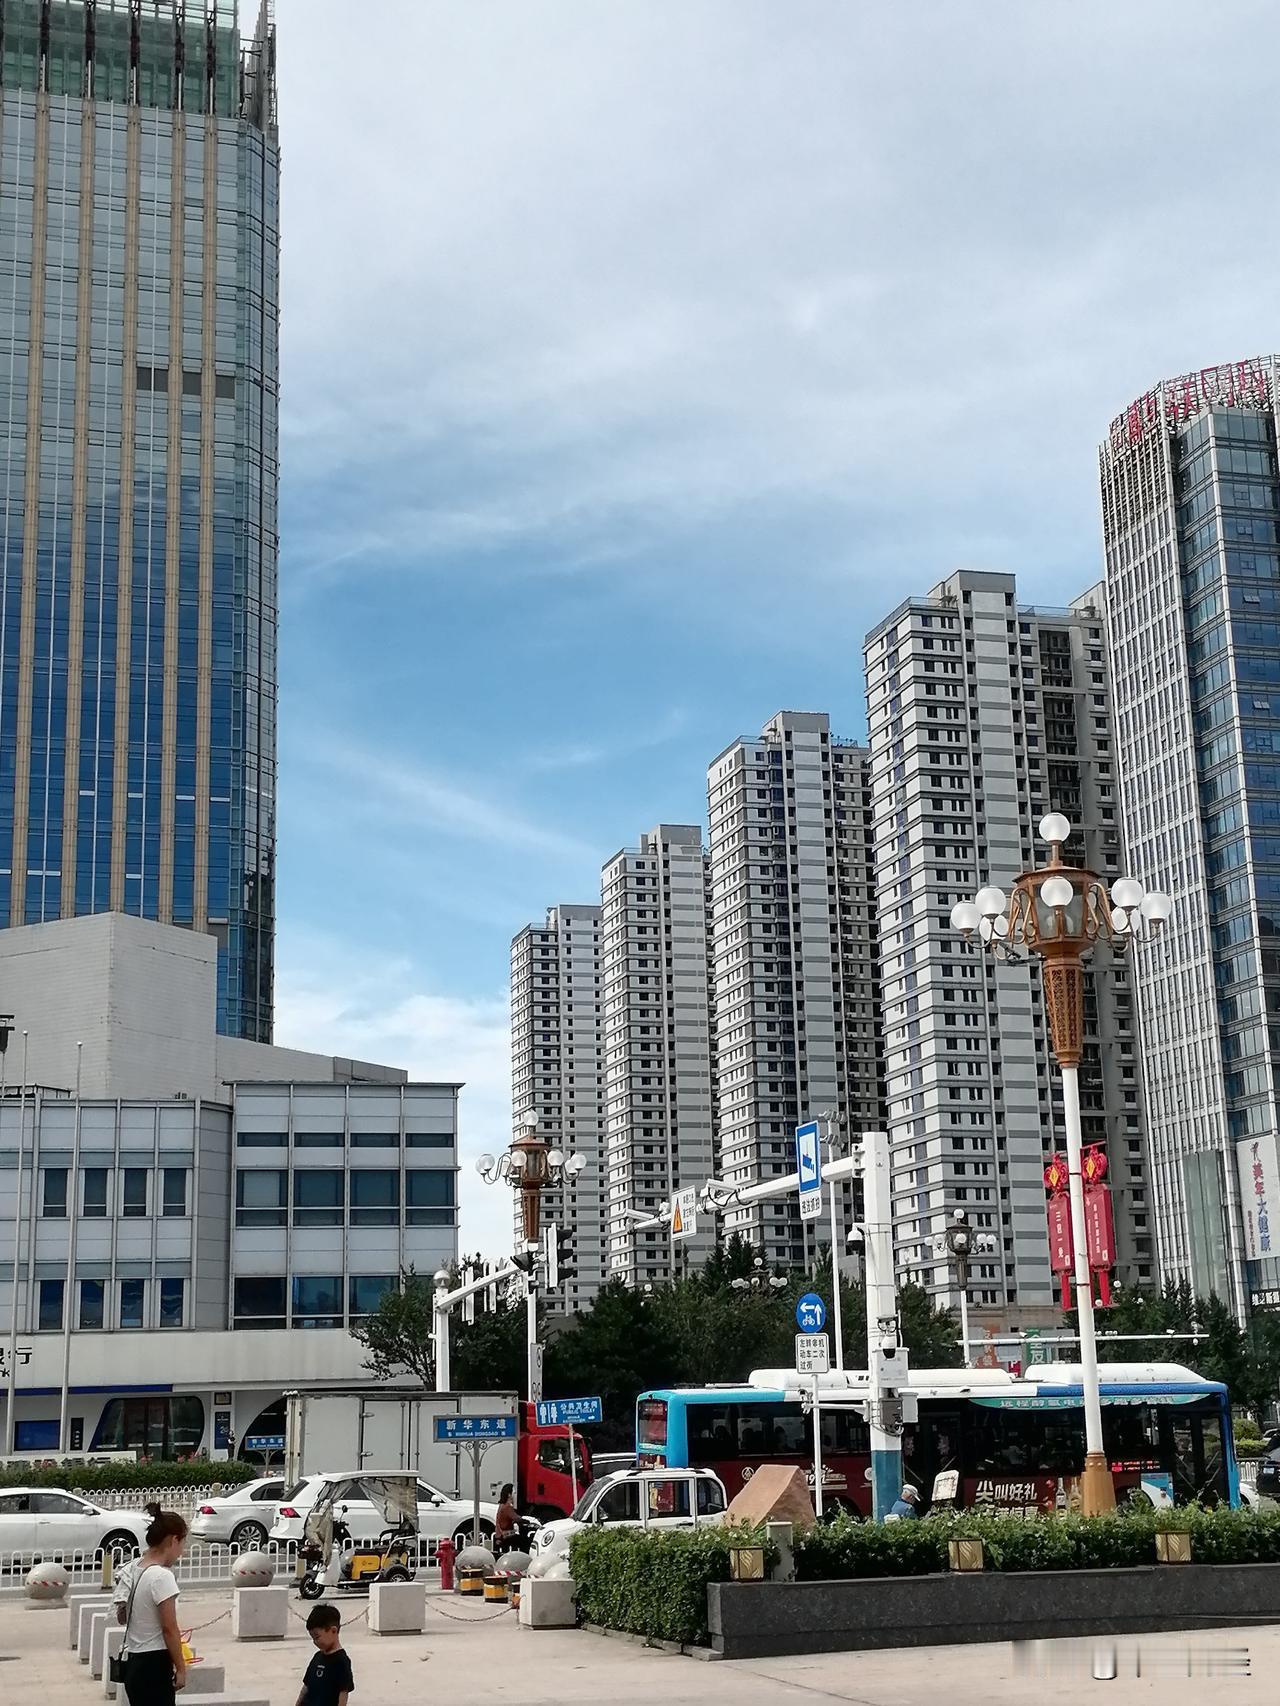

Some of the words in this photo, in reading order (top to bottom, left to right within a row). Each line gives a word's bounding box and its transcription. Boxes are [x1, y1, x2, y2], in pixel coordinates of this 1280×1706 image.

[1252, 1162, 1271, 1251] 美年大健康
[446, 1419, 506, 1430] 新华东道
[975, 1480, 1038, 1503] 尖叫好礼
